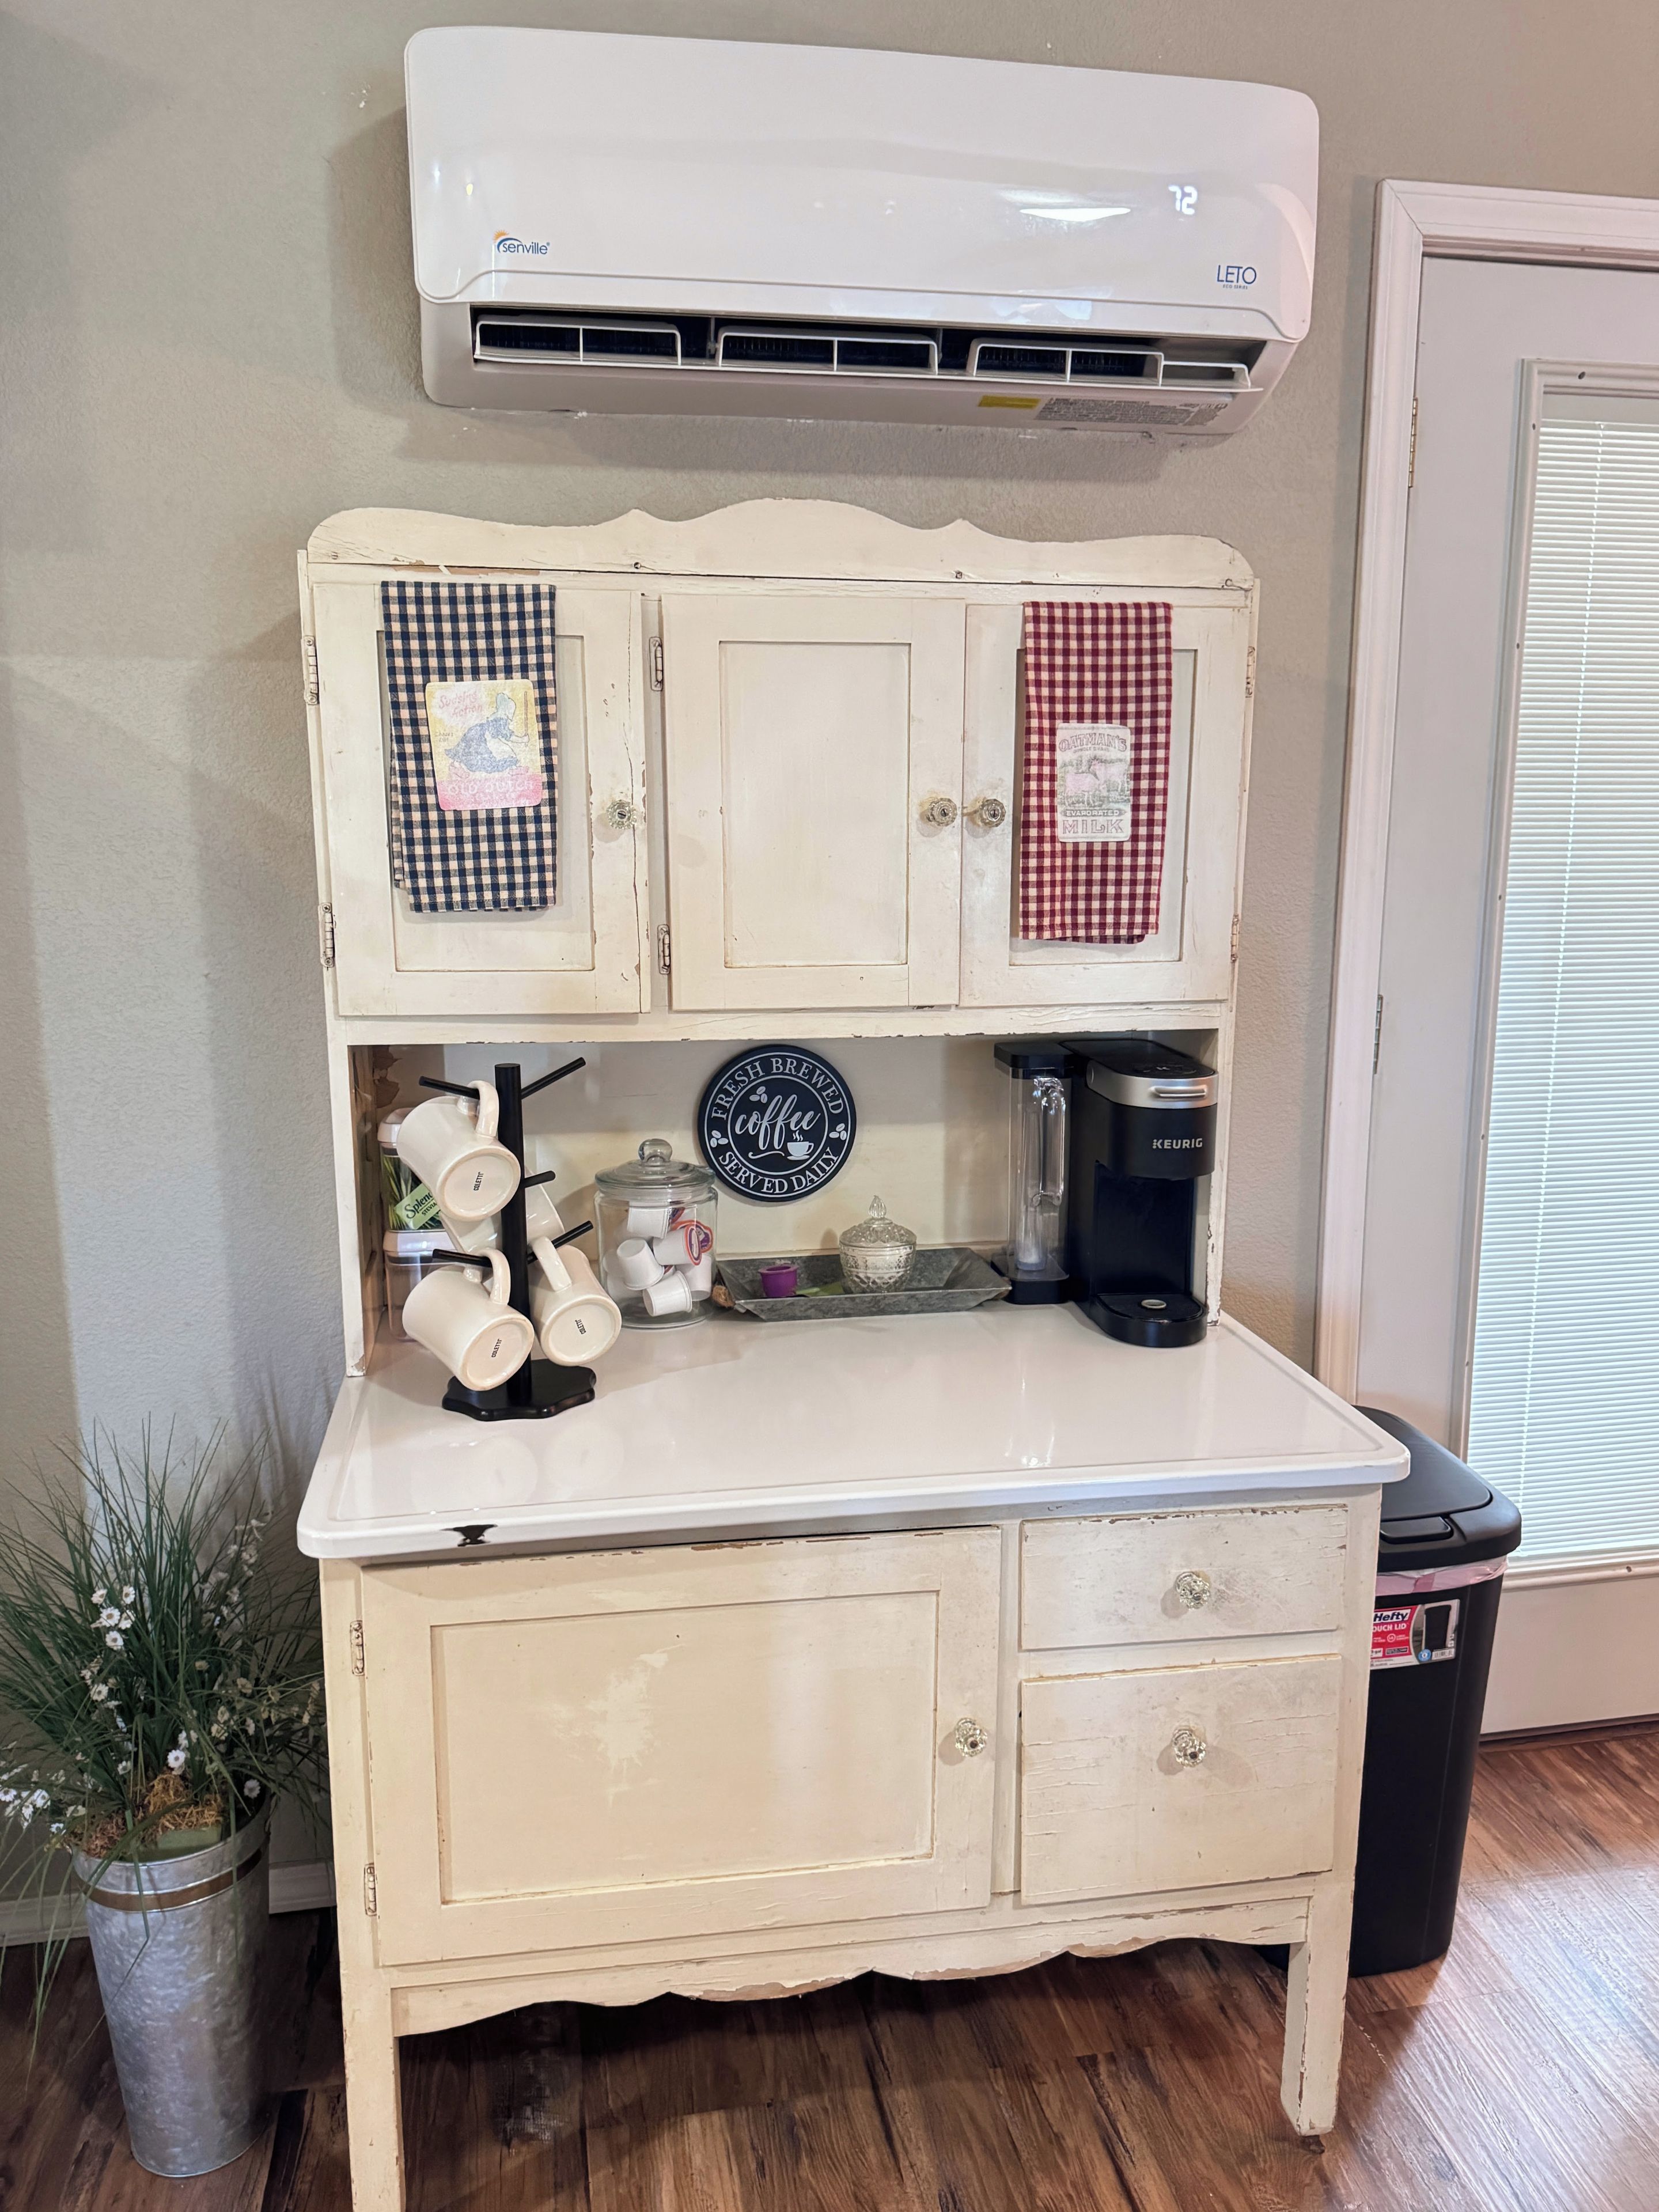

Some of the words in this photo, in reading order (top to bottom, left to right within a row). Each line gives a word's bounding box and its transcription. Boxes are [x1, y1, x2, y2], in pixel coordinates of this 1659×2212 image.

[1168, 185, 1198, 215] 72
[502, 241, 548, 255] senville
[1217, 265, 1257, 285] LETO
[1059, 733, 1127, 752] OATMAN'S
[1063, 819, 1124, 834] MILK
[711, 1061, 765, 1120] FRESH
[771, 1058, 843, 1114] BREWED
[735, 1094, 820, 1150] coffee
[1153, 1138, 1203, 1149] KEURIG
[719, 1152, 788, 1194] SERVED
[790, 1147, 839, 1191] DAILY
[422, 1202, 437, 1216] STEVIA
[1373, 1612, 1408, 1621] Hefty
